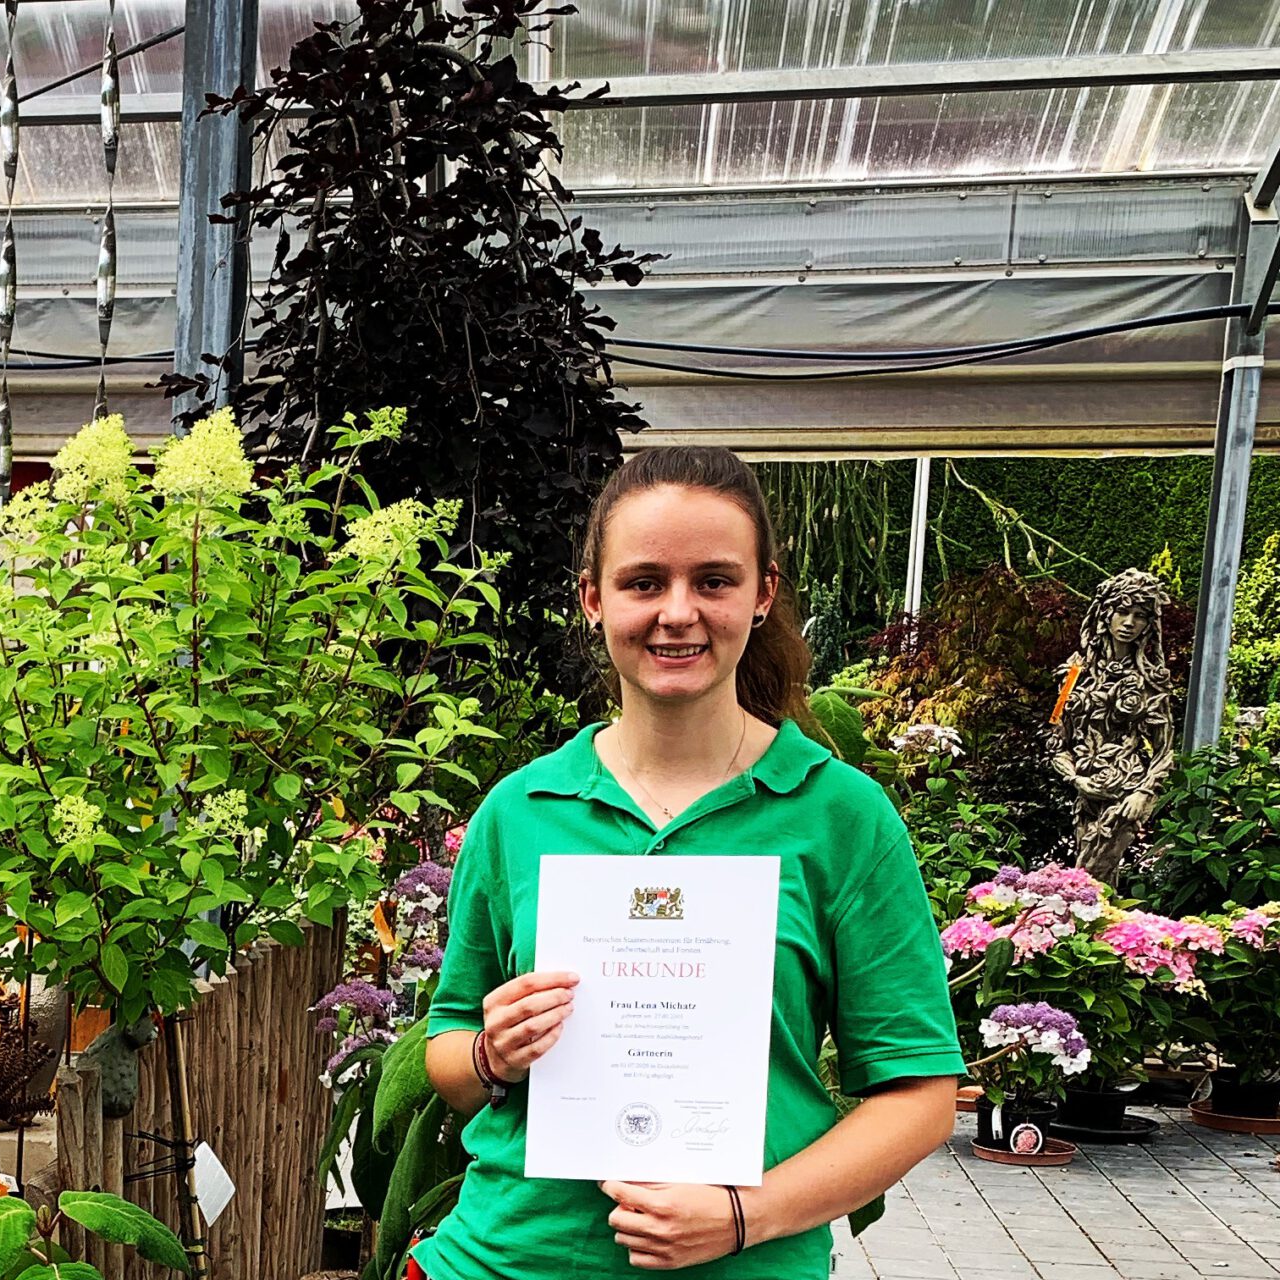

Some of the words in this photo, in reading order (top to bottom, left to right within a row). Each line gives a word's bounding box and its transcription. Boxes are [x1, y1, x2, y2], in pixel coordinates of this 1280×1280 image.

[601, 961, 707, 978] URKUNDE
[610, 1000, 632, 1010] Frau
[634, 1001, 657, 1010] Lena
[660, 1001, 697, 1010] Michatz
[627, 1048, 673, 1058] Gärtnerin
